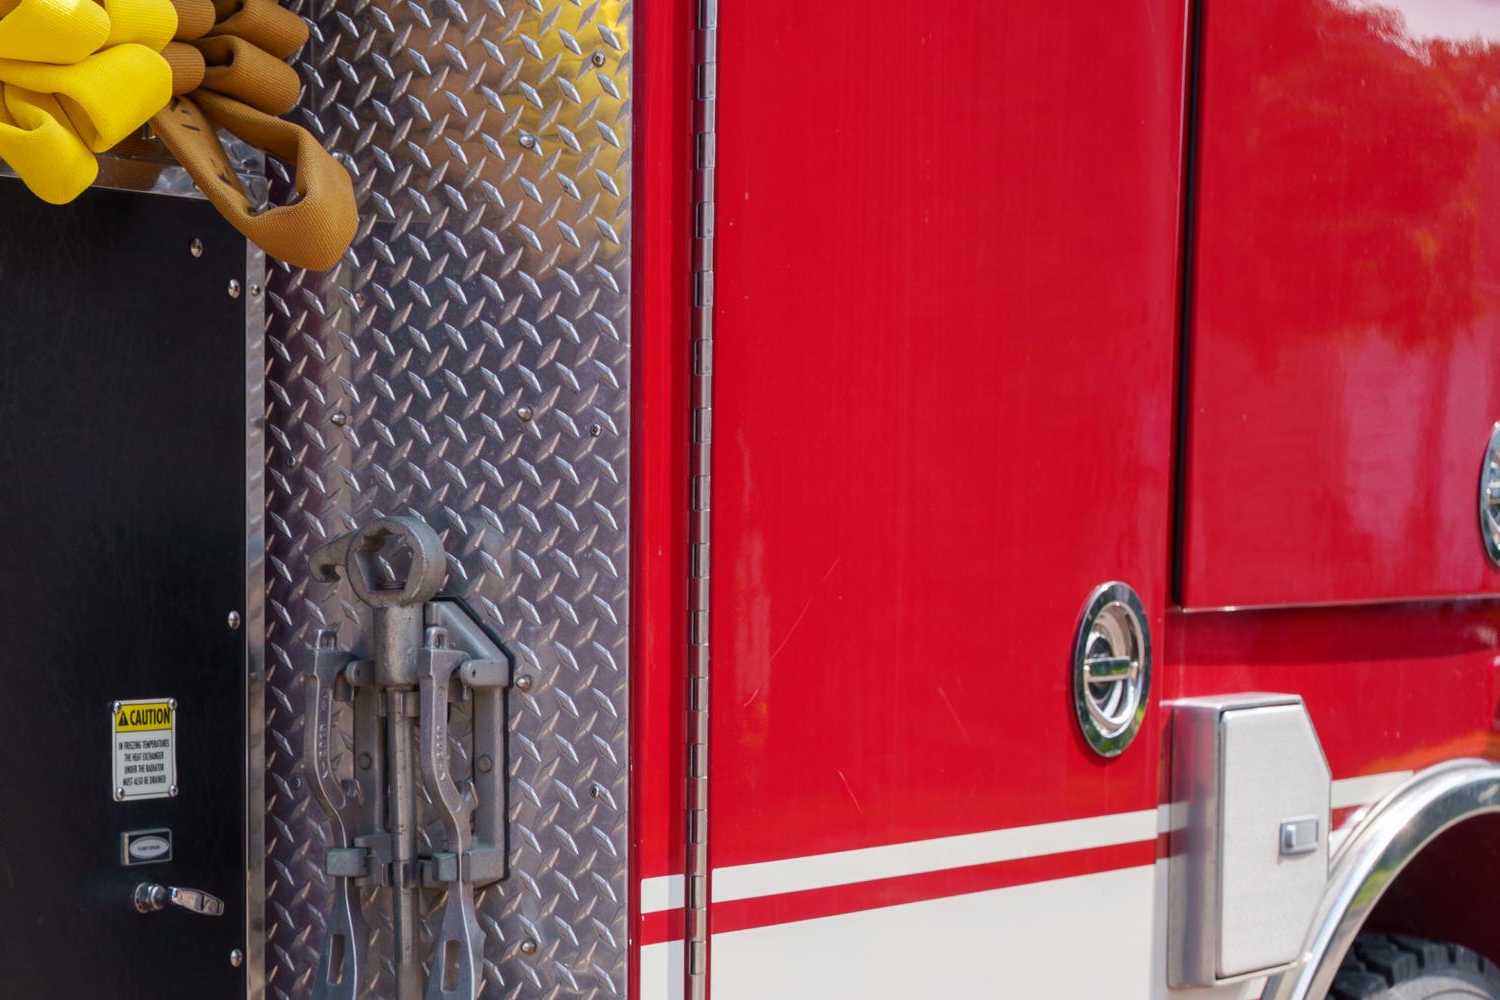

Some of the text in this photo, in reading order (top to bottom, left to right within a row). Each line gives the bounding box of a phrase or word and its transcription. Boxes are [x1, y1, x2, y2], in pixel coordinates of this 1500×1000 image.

[130, 708, 170, 726] CAUTION
[124, 740, 141, 750] FREEZING
[142, 739, 170, 749] TEMPERATURES
[132, 752, 141, 762] HEAT
[142, 751, 164, 761] EXCHANGER
[124, 765, 137, 774] UNDER
[146, 763, 164, 772] RADIATOR
[123, 777, 133, 786] MUST
[134, 776, 143, 785] ALSO
[150, 774, 166, 784] DRAINED
